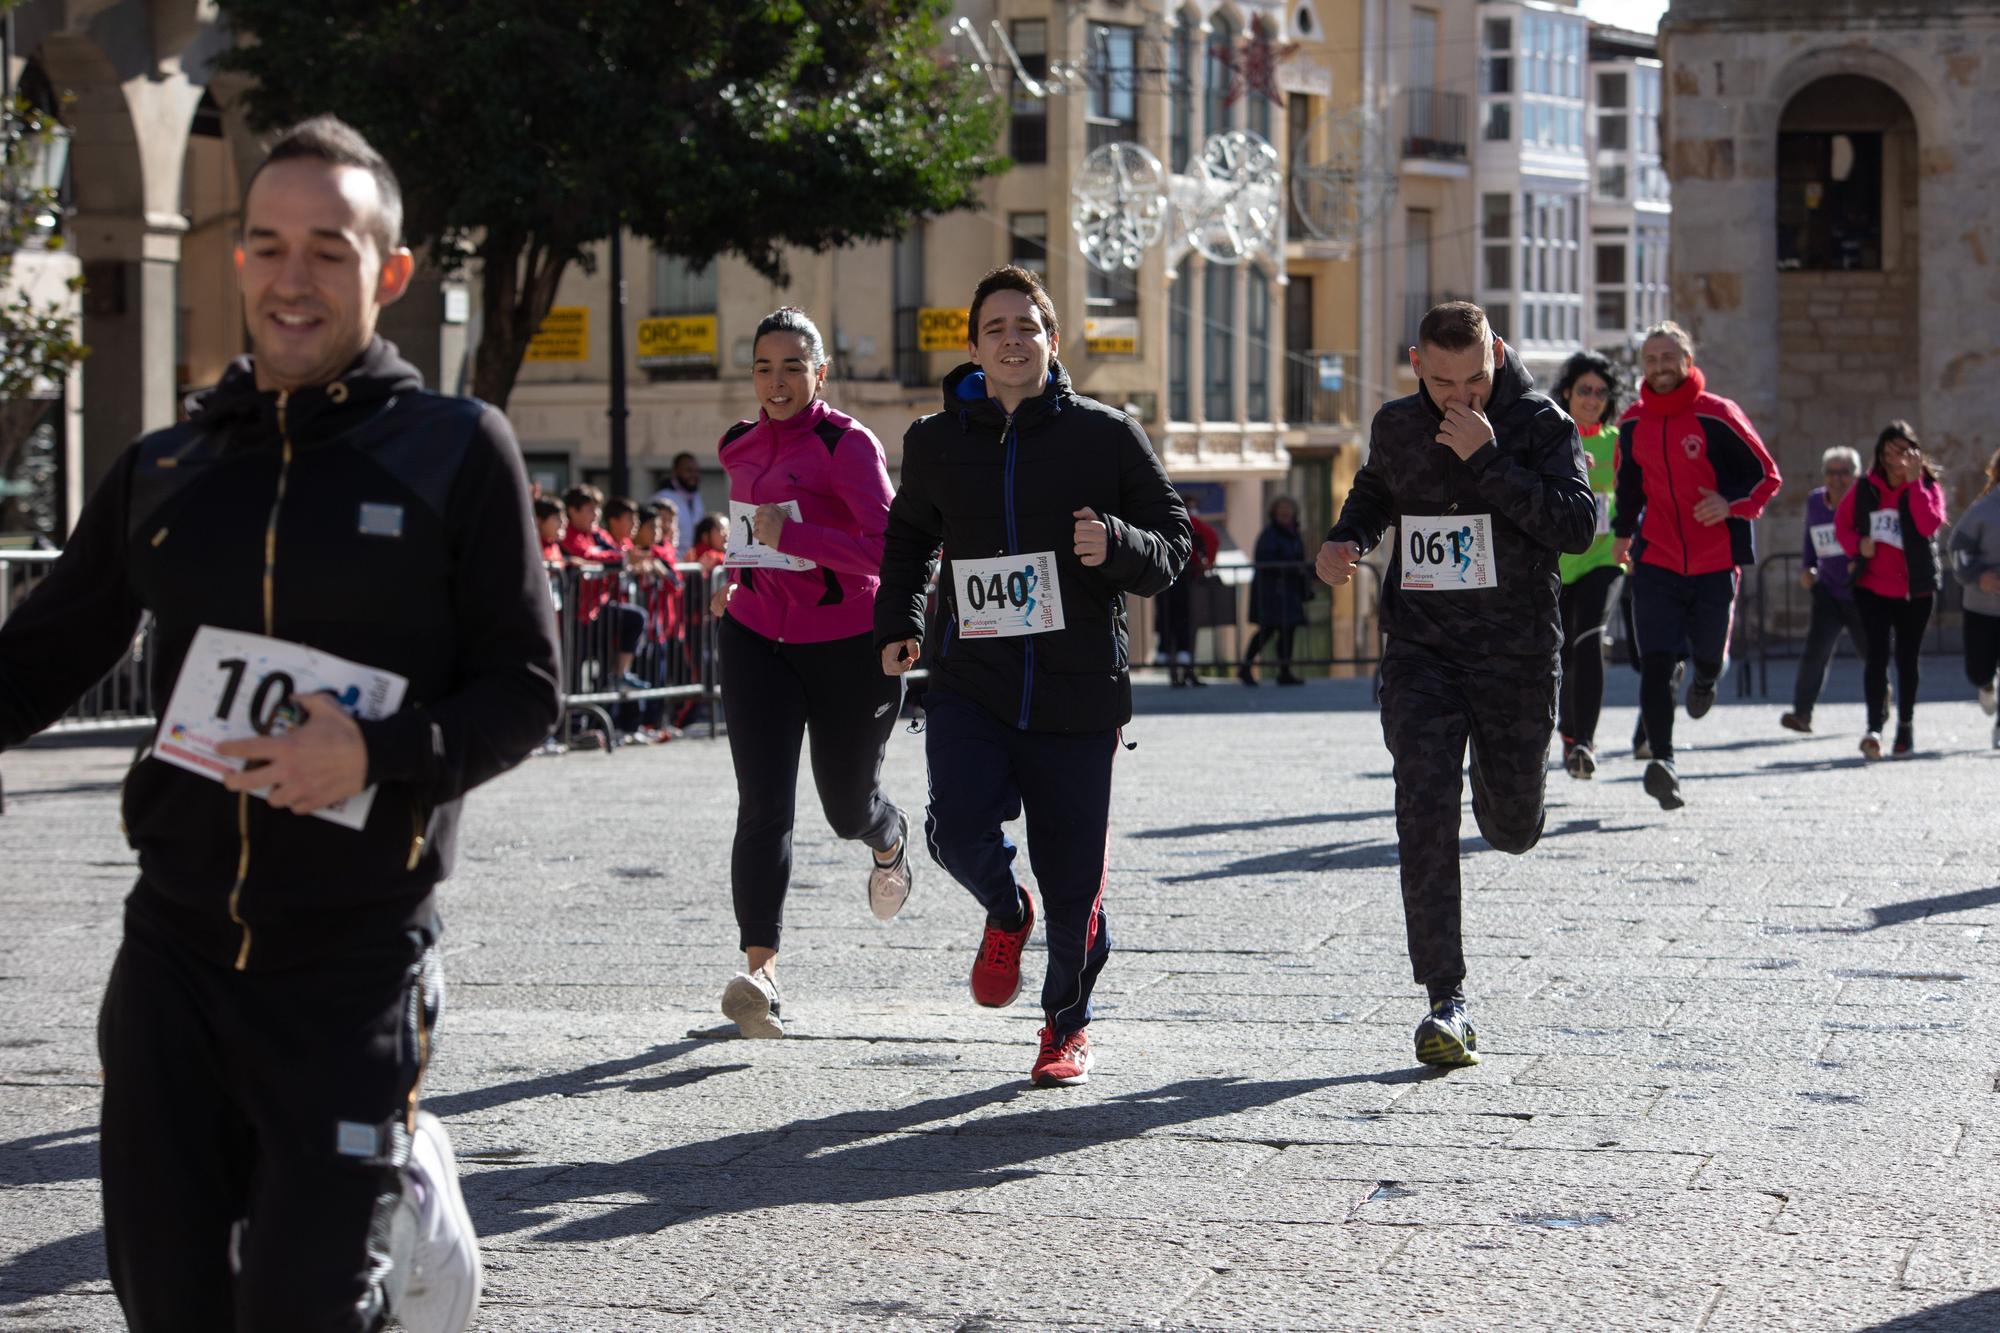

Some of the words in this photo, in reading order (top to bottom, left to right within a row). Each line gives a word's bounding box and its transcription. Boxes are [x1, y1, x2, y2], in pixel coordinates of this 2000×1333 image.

[1410, 530, 1461, 565] 061
[967, 571, 1028, 610] 040
[1036, 555, 1052, 592] solidaridad
[1040, 605, 1054, 629] taller
